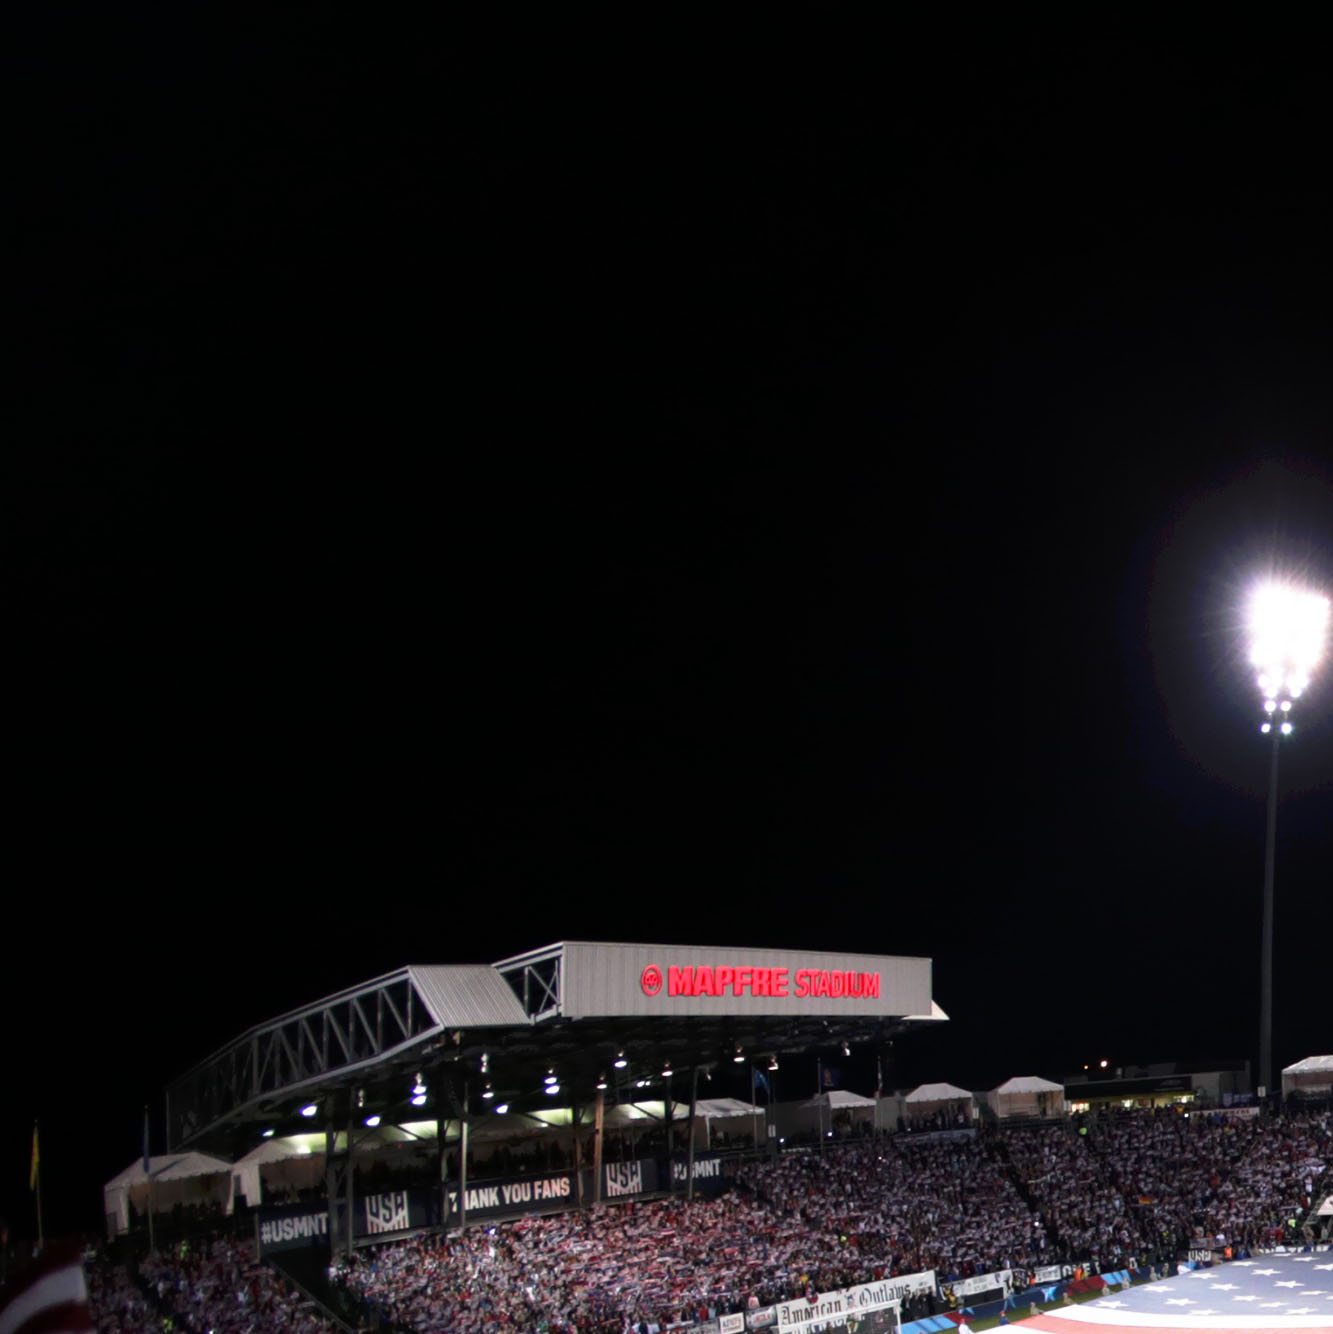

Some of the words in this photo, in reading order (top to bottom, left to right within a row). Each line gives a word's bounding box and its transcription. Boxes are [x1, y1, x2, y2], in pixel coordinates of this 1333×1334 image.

[668, 966, 789, 997] MAPFRE
[794, 968, 879, 998] STADIUM
[502, 1182, 532, 1204] YOU
[534, 1176, 571, 1200] FANS
[261, 1212, 329, 1244] #USMNT
[780, 1299, 842, 1327] American
[859, 1284, 911, 1306] Outlaws
